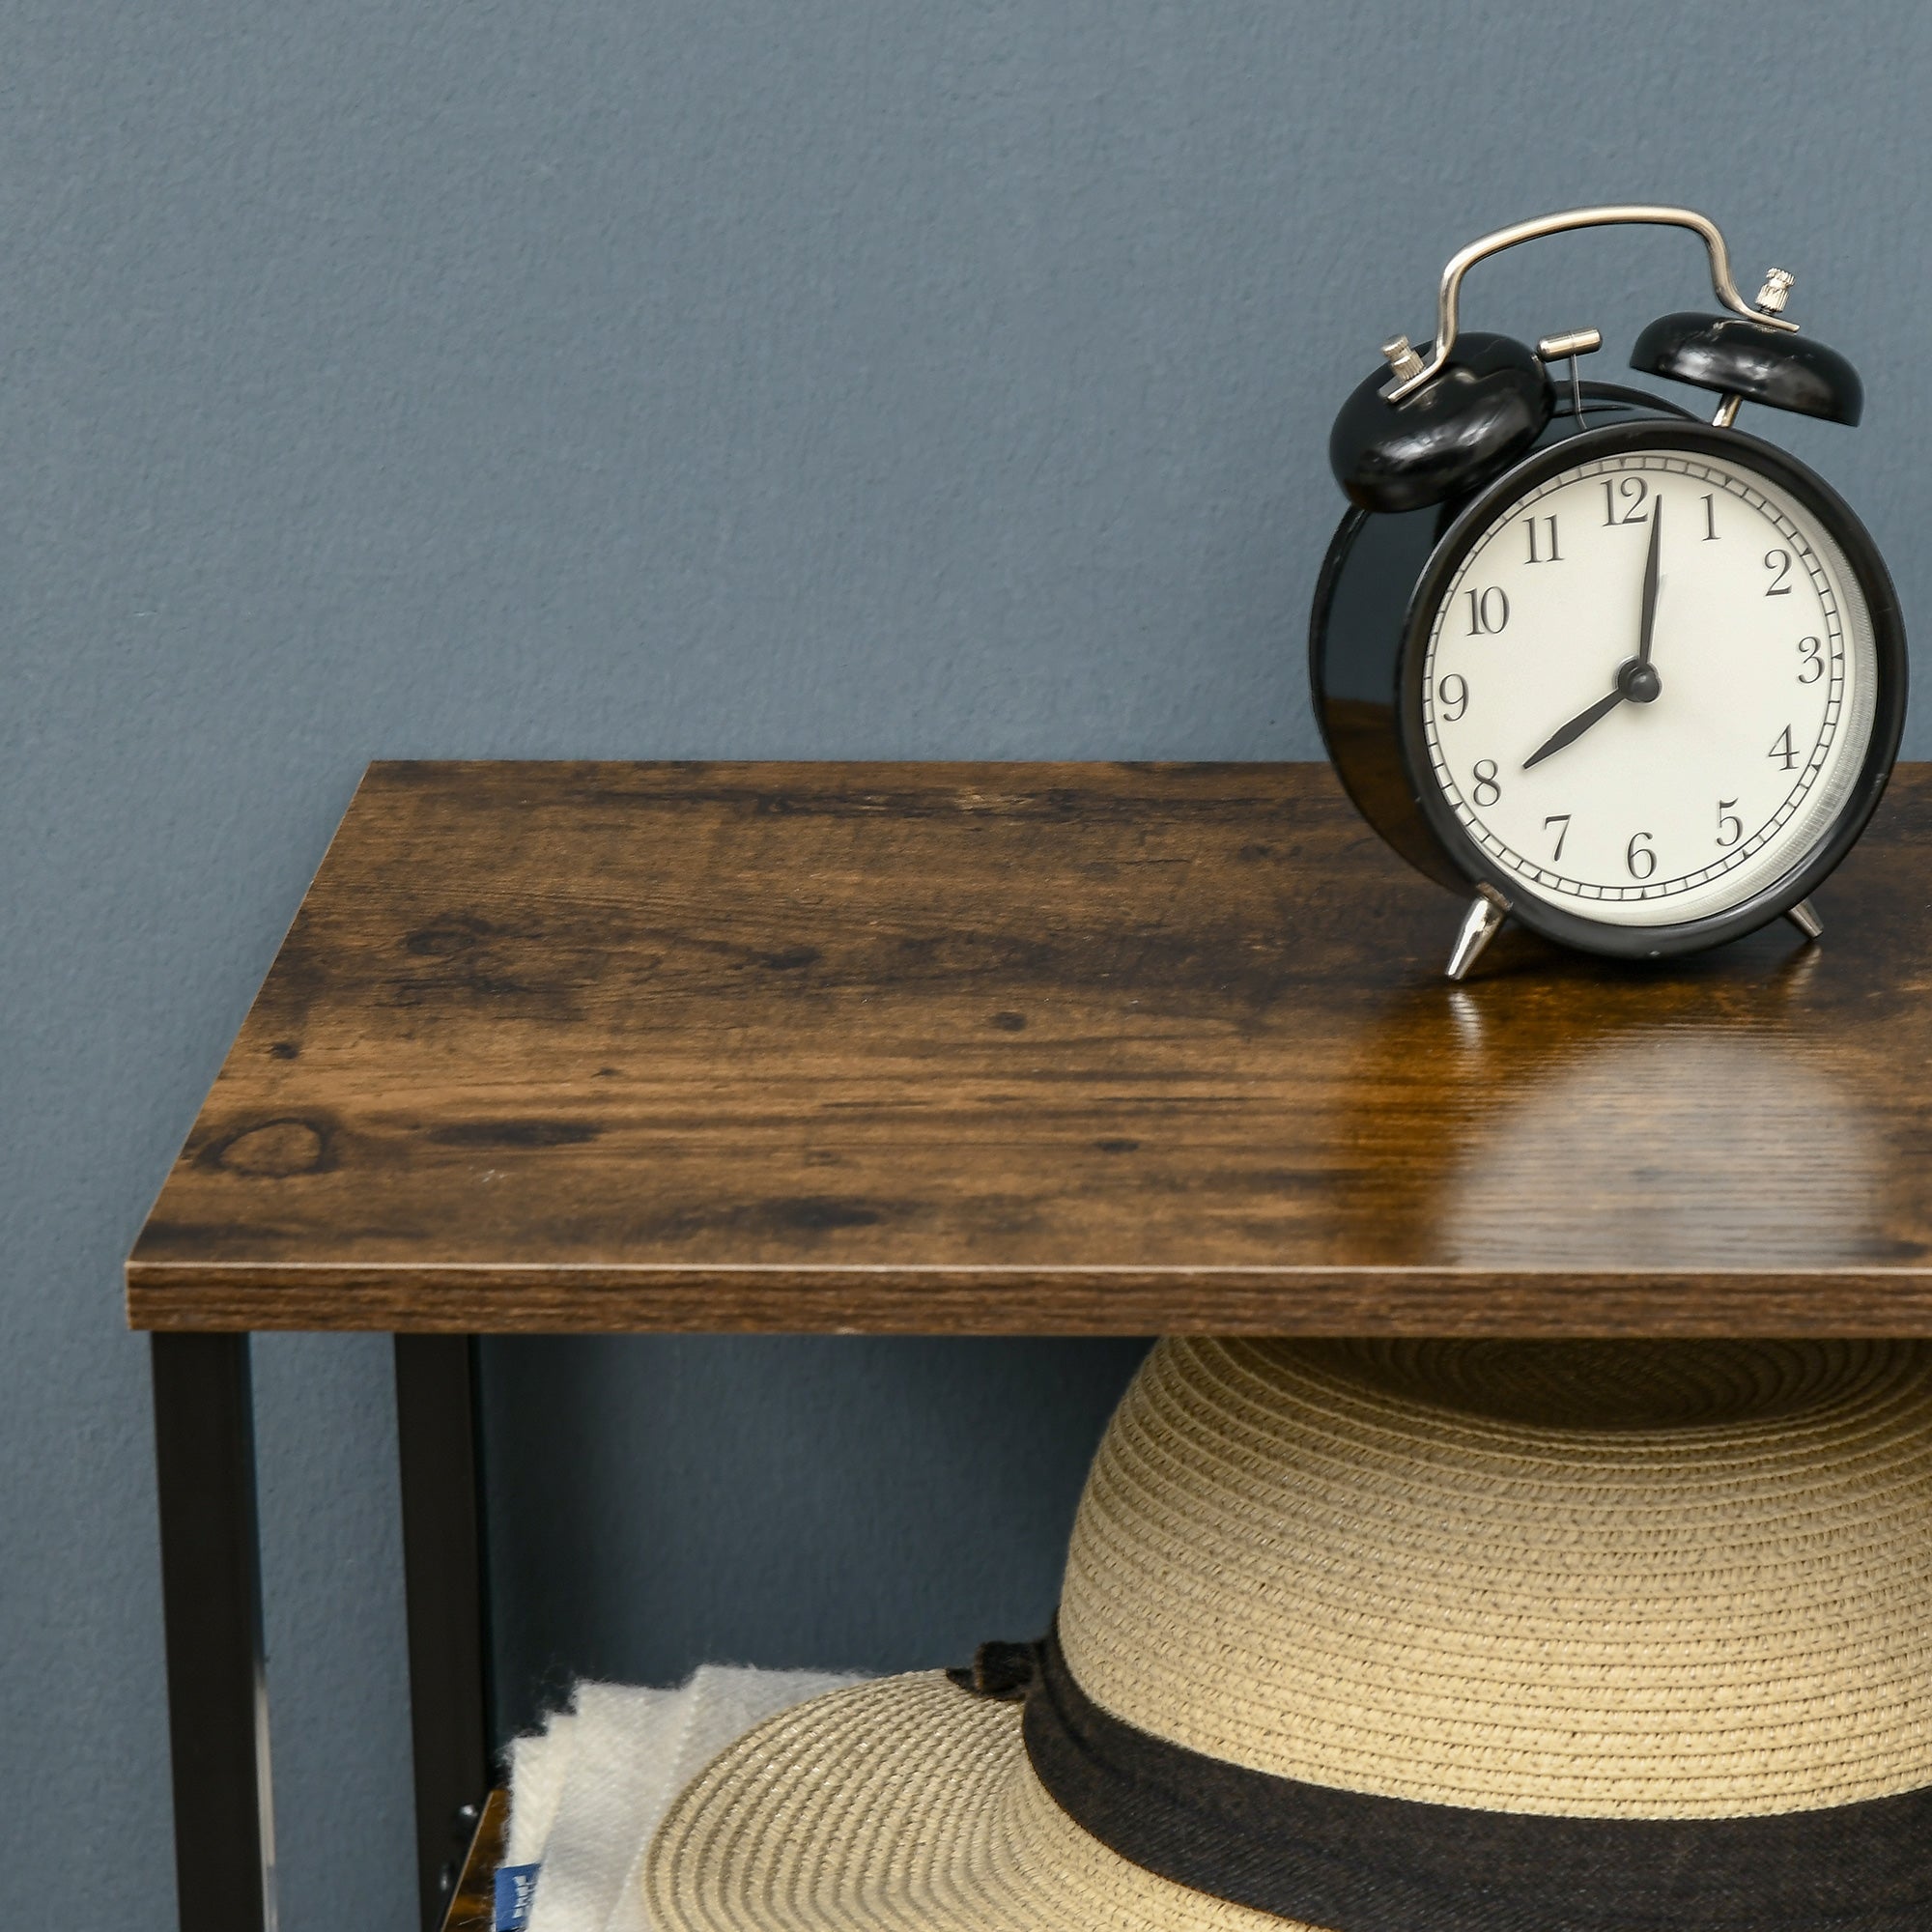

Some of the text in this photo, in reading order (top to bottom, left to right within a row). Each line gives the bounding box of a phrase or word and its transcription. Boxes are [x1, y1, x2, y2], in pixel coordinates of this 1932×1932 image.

[1600, 476, 1649, 527] 12
[1700, 493, 1721, 541] 1
[1522, 514, 1565, 564] 11
[1764, 549, 1793, 596] 2
[1463, 586, 1510, 636] 10
[1798, 637, 1825, 684] 3
[1438, 674, 1468, 722] 9
[1768, 724, 1800, 771] 4
[1472, 759, 1501, 807] 8
[1545, 814, 1572, 862] 7
[1717, 798, 1744, 847] 5
[1627, 832, 1657, 879] 6
